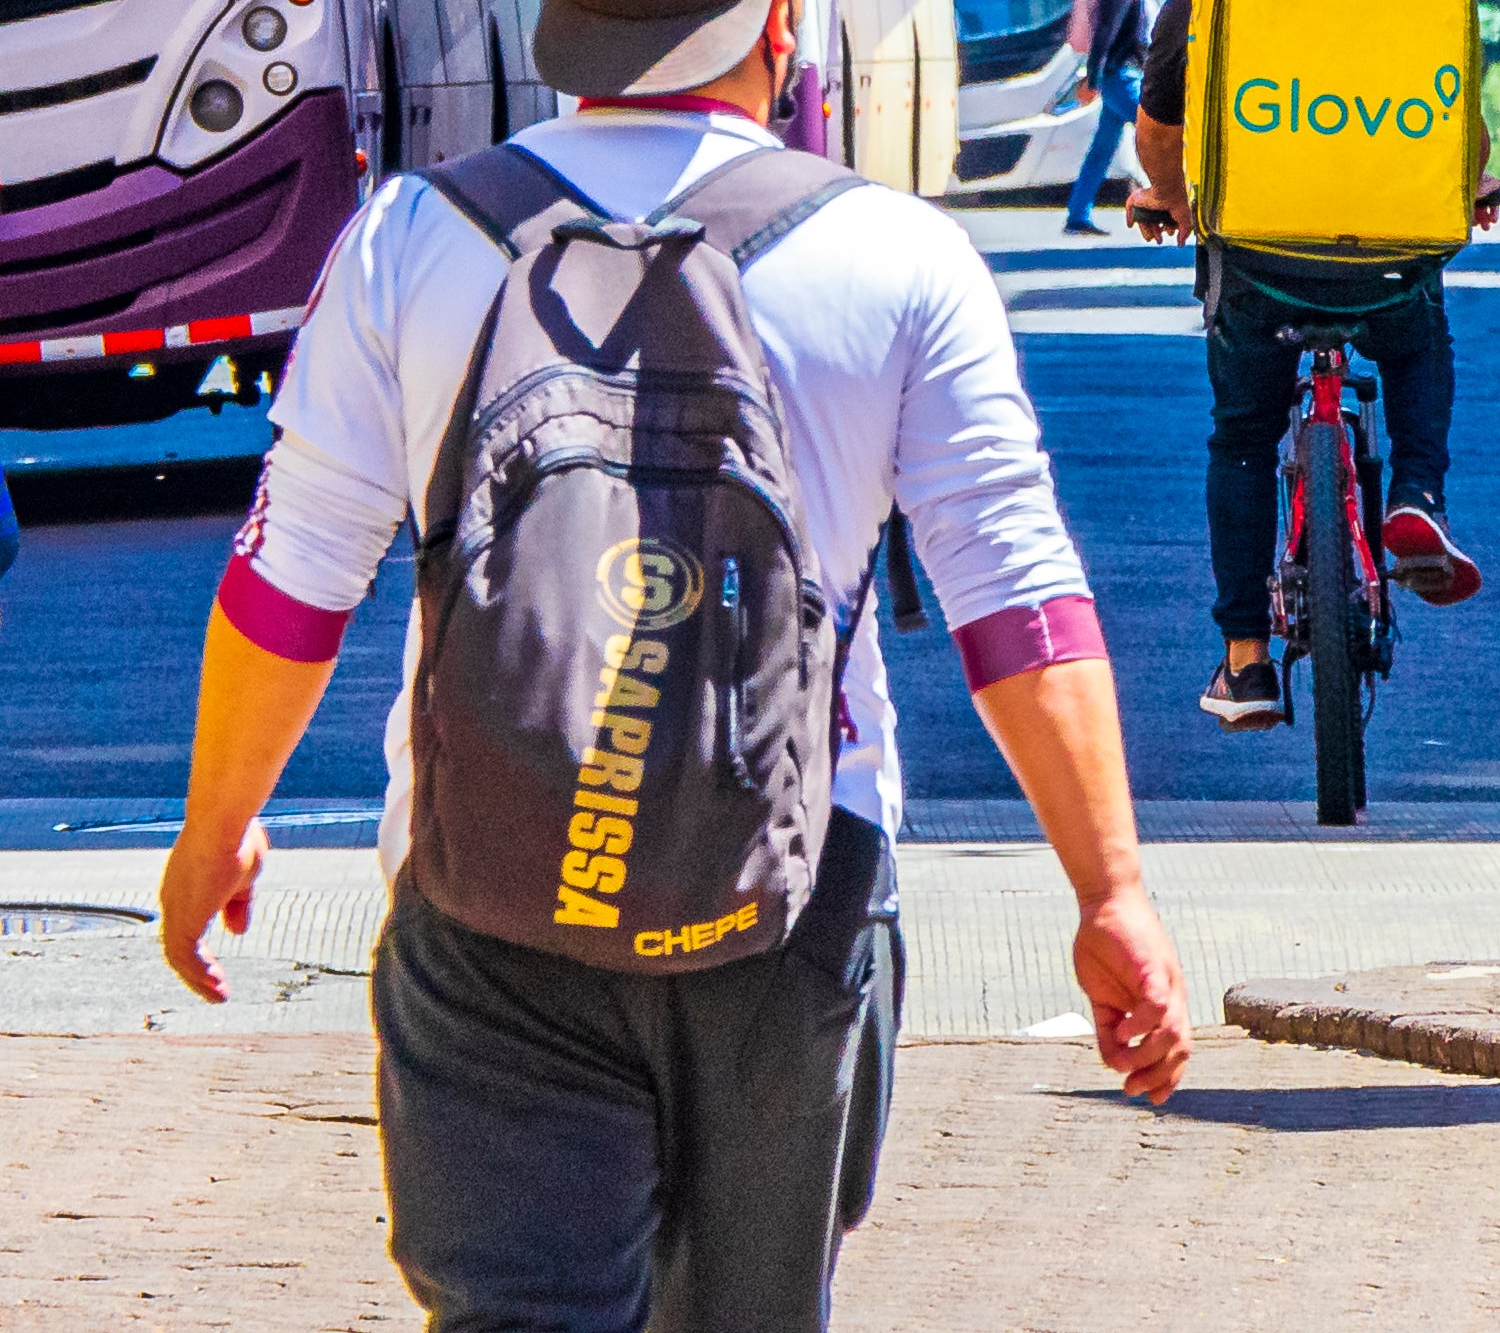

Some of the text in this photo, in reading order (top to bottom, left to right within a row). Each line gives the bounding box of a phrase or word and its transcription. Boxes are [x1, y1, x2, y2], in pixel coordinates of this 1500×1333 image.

[1234, 77, 1433, 139] Glovo
[552, 634, 670, 929] SAPRISSA
[634, 902, 759, 957] CHEPE
